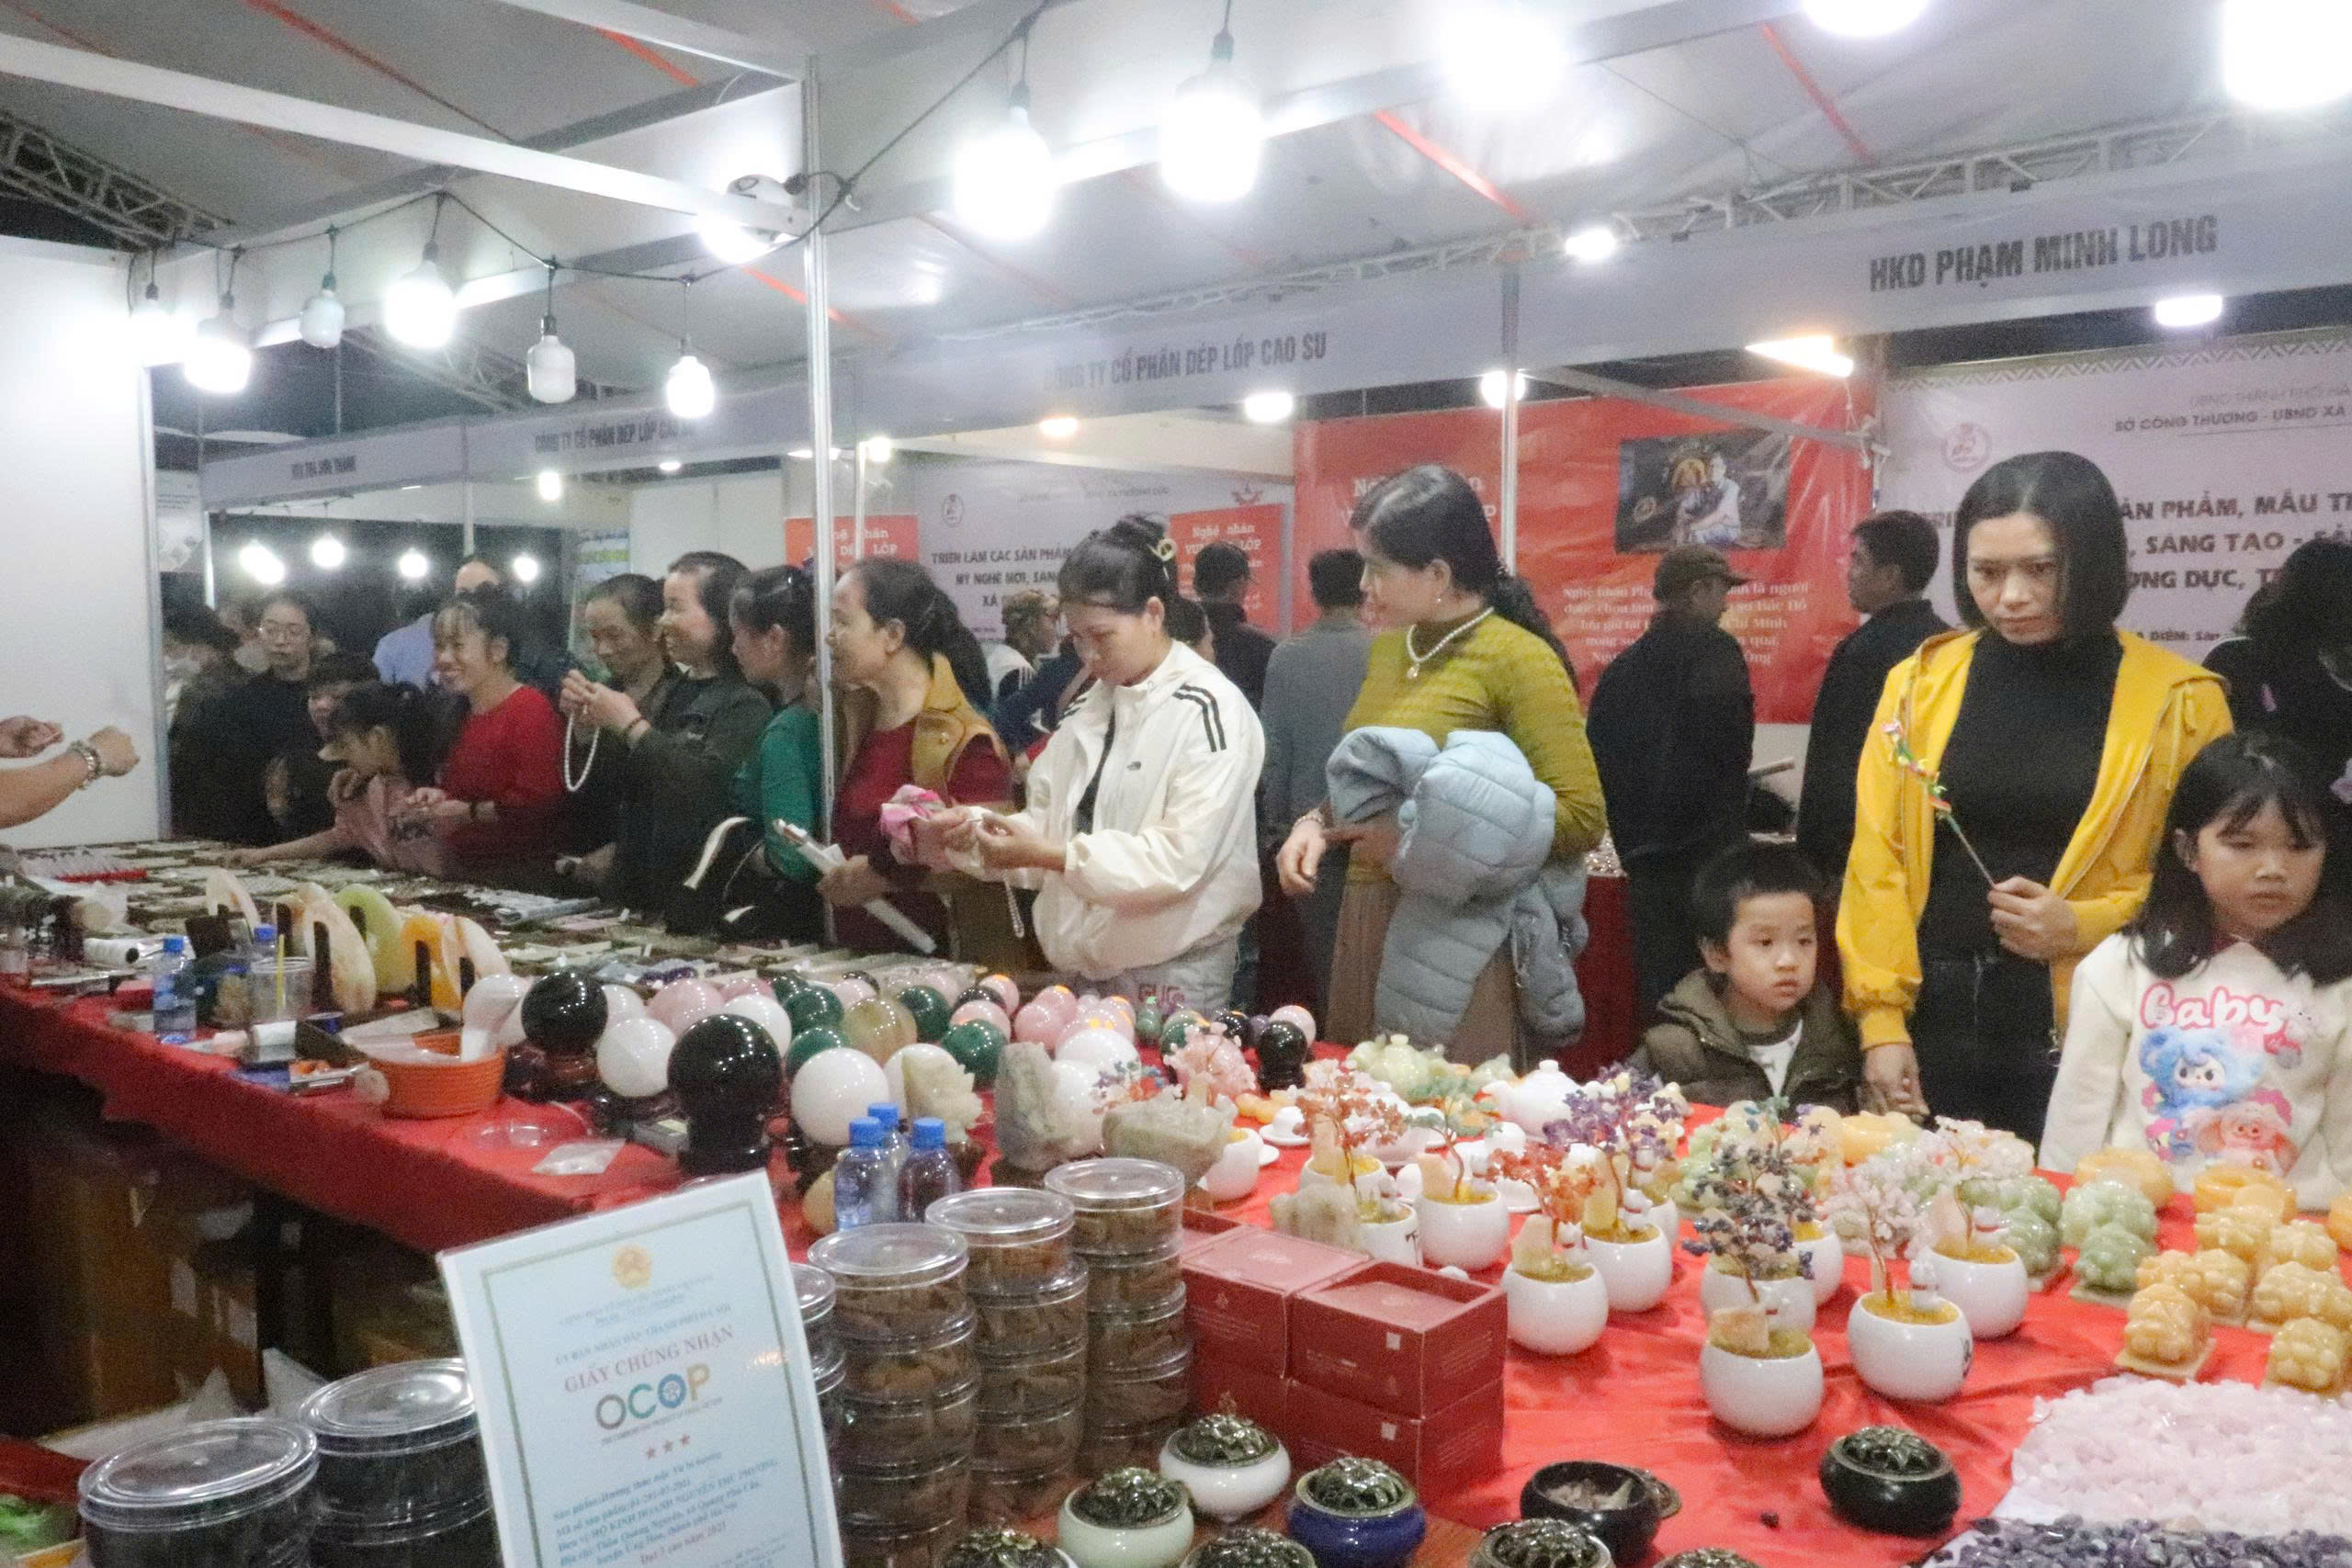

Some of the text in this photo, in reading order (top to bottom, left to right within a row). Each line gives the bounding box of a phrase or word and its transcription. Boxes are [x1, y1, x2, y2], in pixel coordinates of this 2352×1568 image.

[1870, 215, 2218, 292] HKD PHẠM MINH LONG
[1185, 341, 1217, 376] DÉP
[1261, 335, 1295, 366] CAO
[1301, 331, 1327, 361] SU
[2140, 414, 2188, 431] CÔNG
[2272, 406, 2318, 421] UBND
[2121, 498, 2154, 520] ẢN
[2224, 531, 2285, 556] TẠO
[563, 1323, 734, 1393] GIẤY CHỨNG NHẬN
[594, 1361, 711, 1431] OCOP
